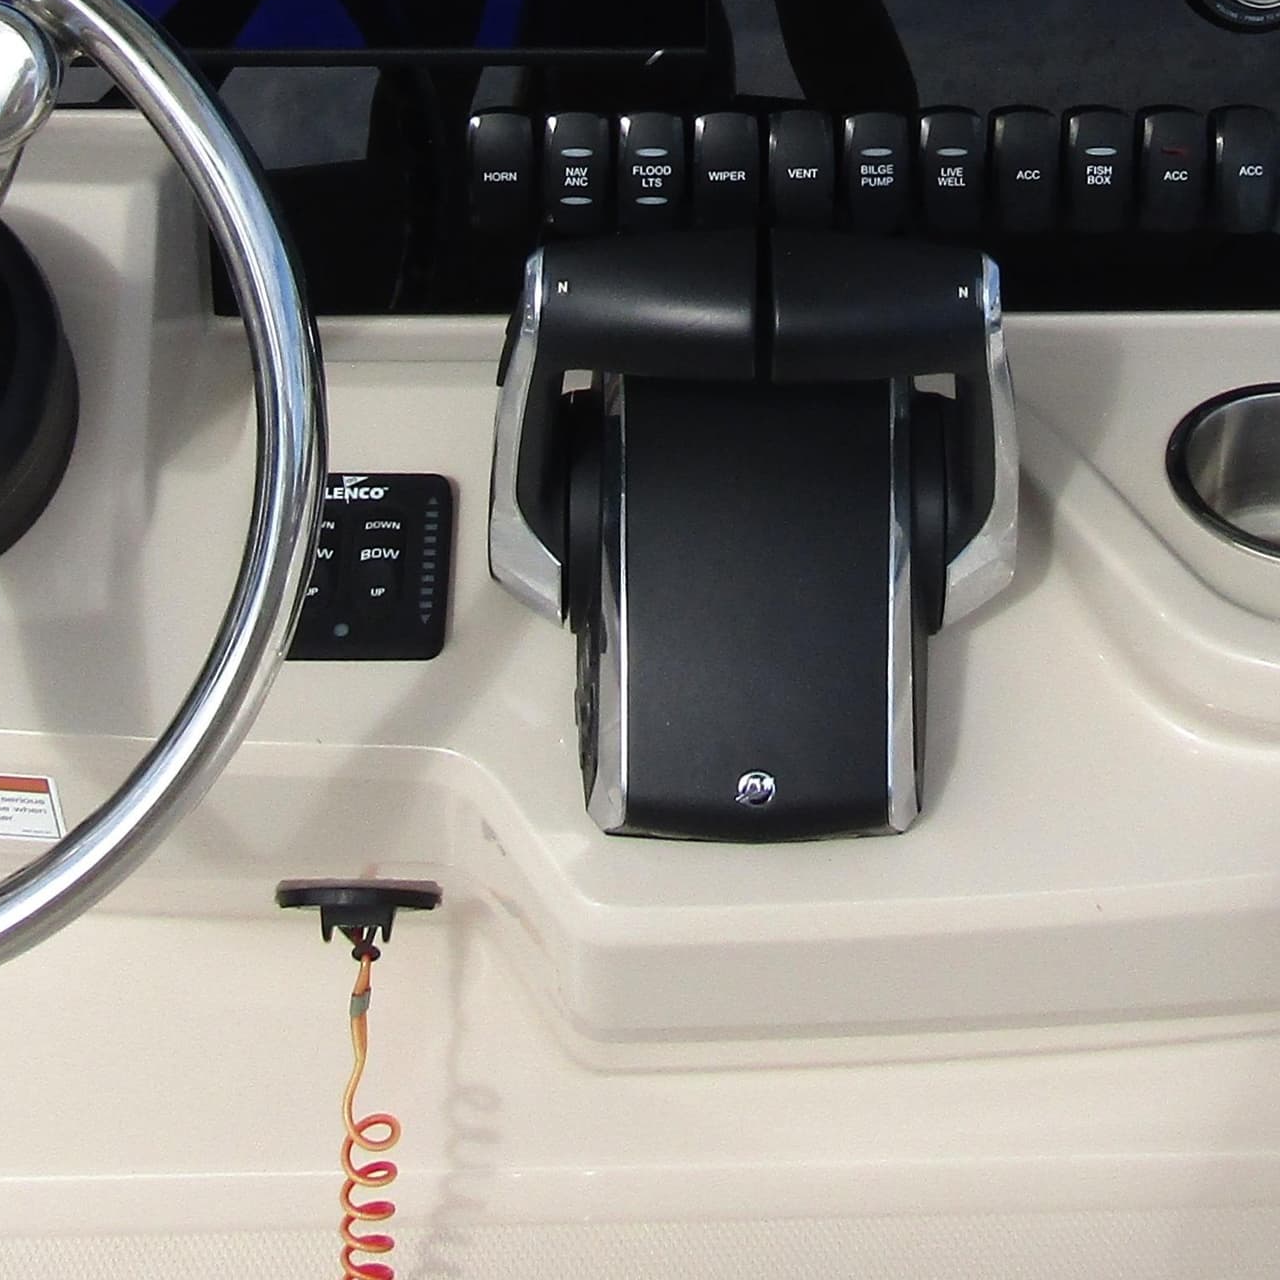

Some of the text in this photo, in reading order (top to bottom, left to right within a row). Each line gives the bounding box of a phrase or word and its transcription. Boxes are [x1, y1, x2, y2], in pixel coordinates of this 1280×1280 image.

[565, 167, 588, 177] NAV
[632, 165, 672, 176] FLOOD
[787, 168, 818, 179] VENT
[860, 164, 894, 175] BILGE
[940, 167, 963, 177] LIVE
[1086, 165, 1112, 175] FISH
[1239, 166, 1263, 176] ACC
[484, 172, 517, 182] HORN
[708, 171, 746, 182] WIPER
[1016, 170, 1041, 181] ACC
[1087, 175, 1111, 185] BOX
[1163, 171, 1188, 181] ACC
[564, 177, 589, 187] ANC
[642, 178, 663, 188] LTS
[861, 176, 894, 187] PUMP
[937, 177, 966, 187] WELL
[558, 281, 568, 294] N
[958, 287, 969, 298] N
[324, 487, 385, 500] LENCO
[365, 521, 401, 530] DOWN
[360, 548, 400, 561] BOW
[370, 587, 386, 597] UP
